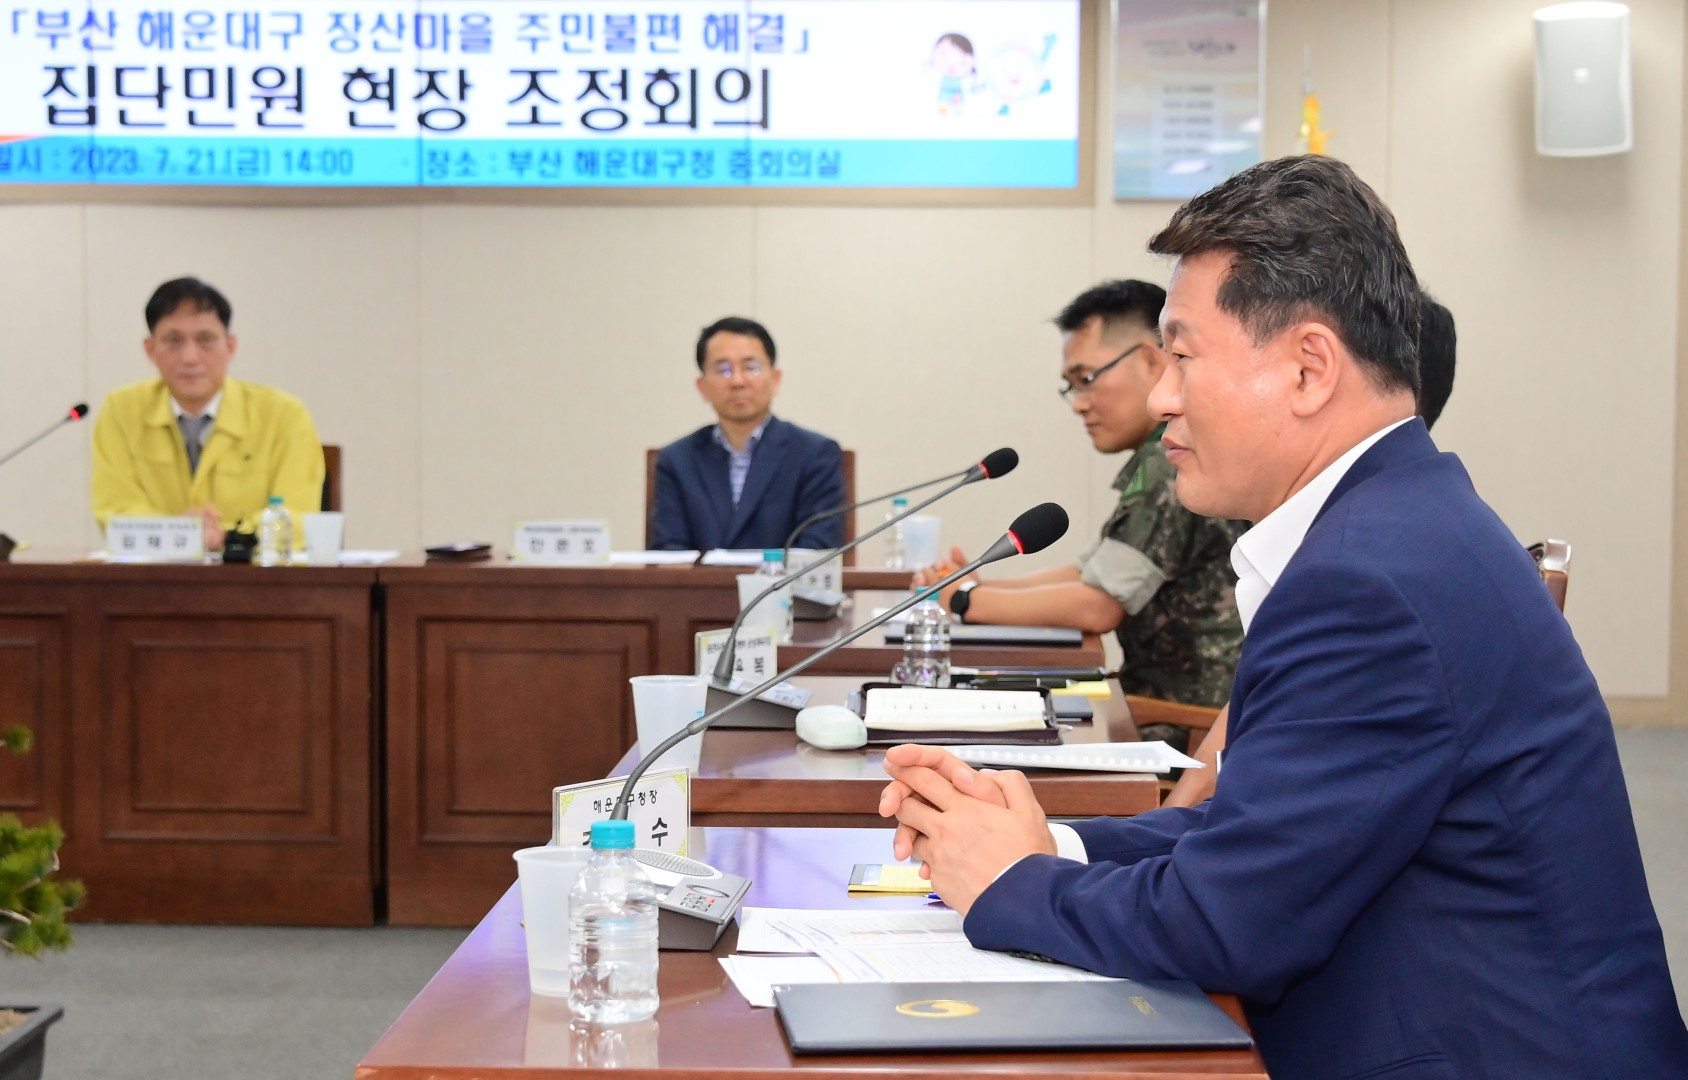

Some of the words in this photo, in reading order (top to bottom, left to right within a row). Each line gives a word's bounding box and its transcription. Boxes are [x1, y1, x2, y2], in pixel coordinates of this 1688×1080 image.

[137, 10, 304, 52] 해운대구
[327, 11, 493, 53] 장산마을
[517, 12, 682, 54] 주민불편
[42, 64, 305, 129] 집단민원
[342, 65, 473, 132] 현장
[506, 67, 770, 132] 조정회의
[283, 147, 355, 177] 14:00
[428, 148, 480, 179] 장소
[507, 149, 563, 179] 부산
[572, 148, 715, 180] 해운대구청
[593, 789, 658, 813] 해운구청장
